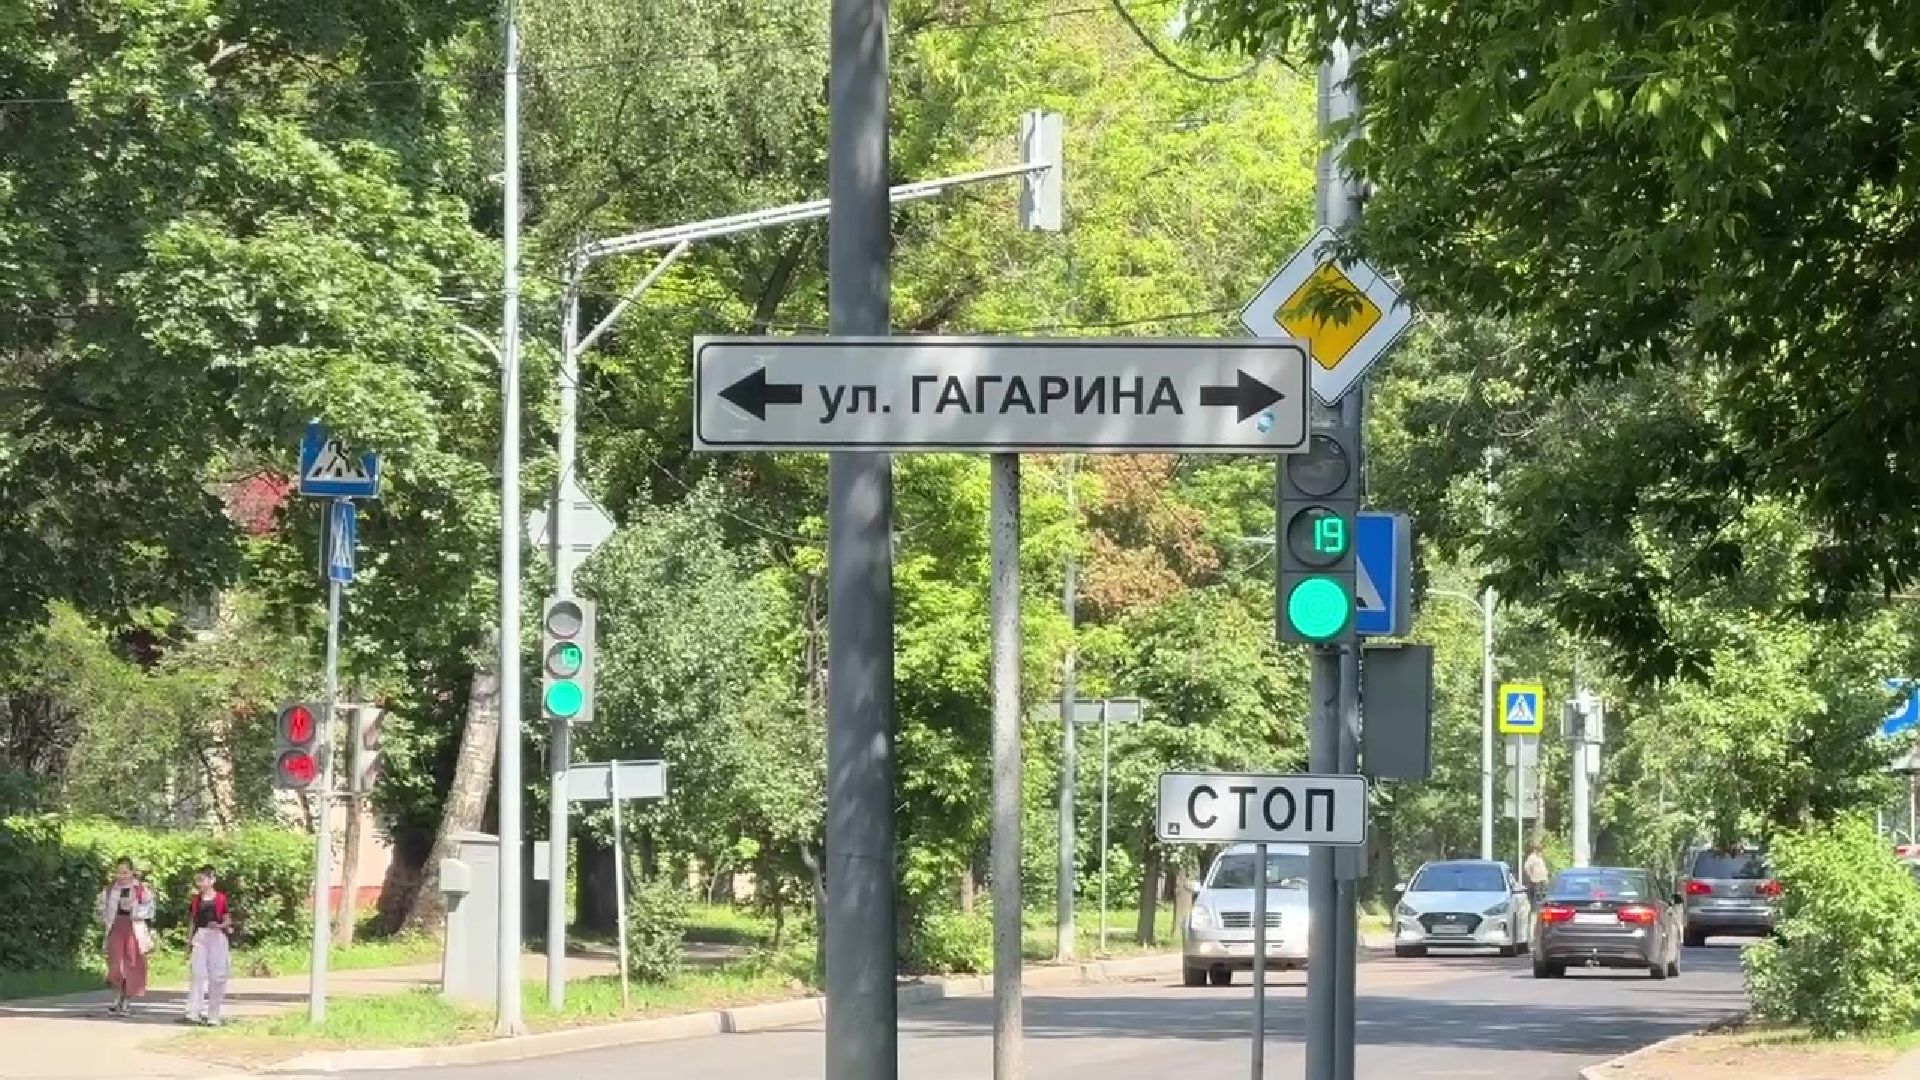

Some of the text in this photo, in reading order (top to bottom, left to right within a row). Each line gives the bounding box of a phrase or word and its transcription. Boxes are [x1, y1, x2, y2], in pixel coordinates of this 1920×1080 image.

[819, 375, 1184, 424] ул. ГАГАРИНА
[1314, 518, 1344, 552] 19
[1187, 784, 1334, 832] СТОП
